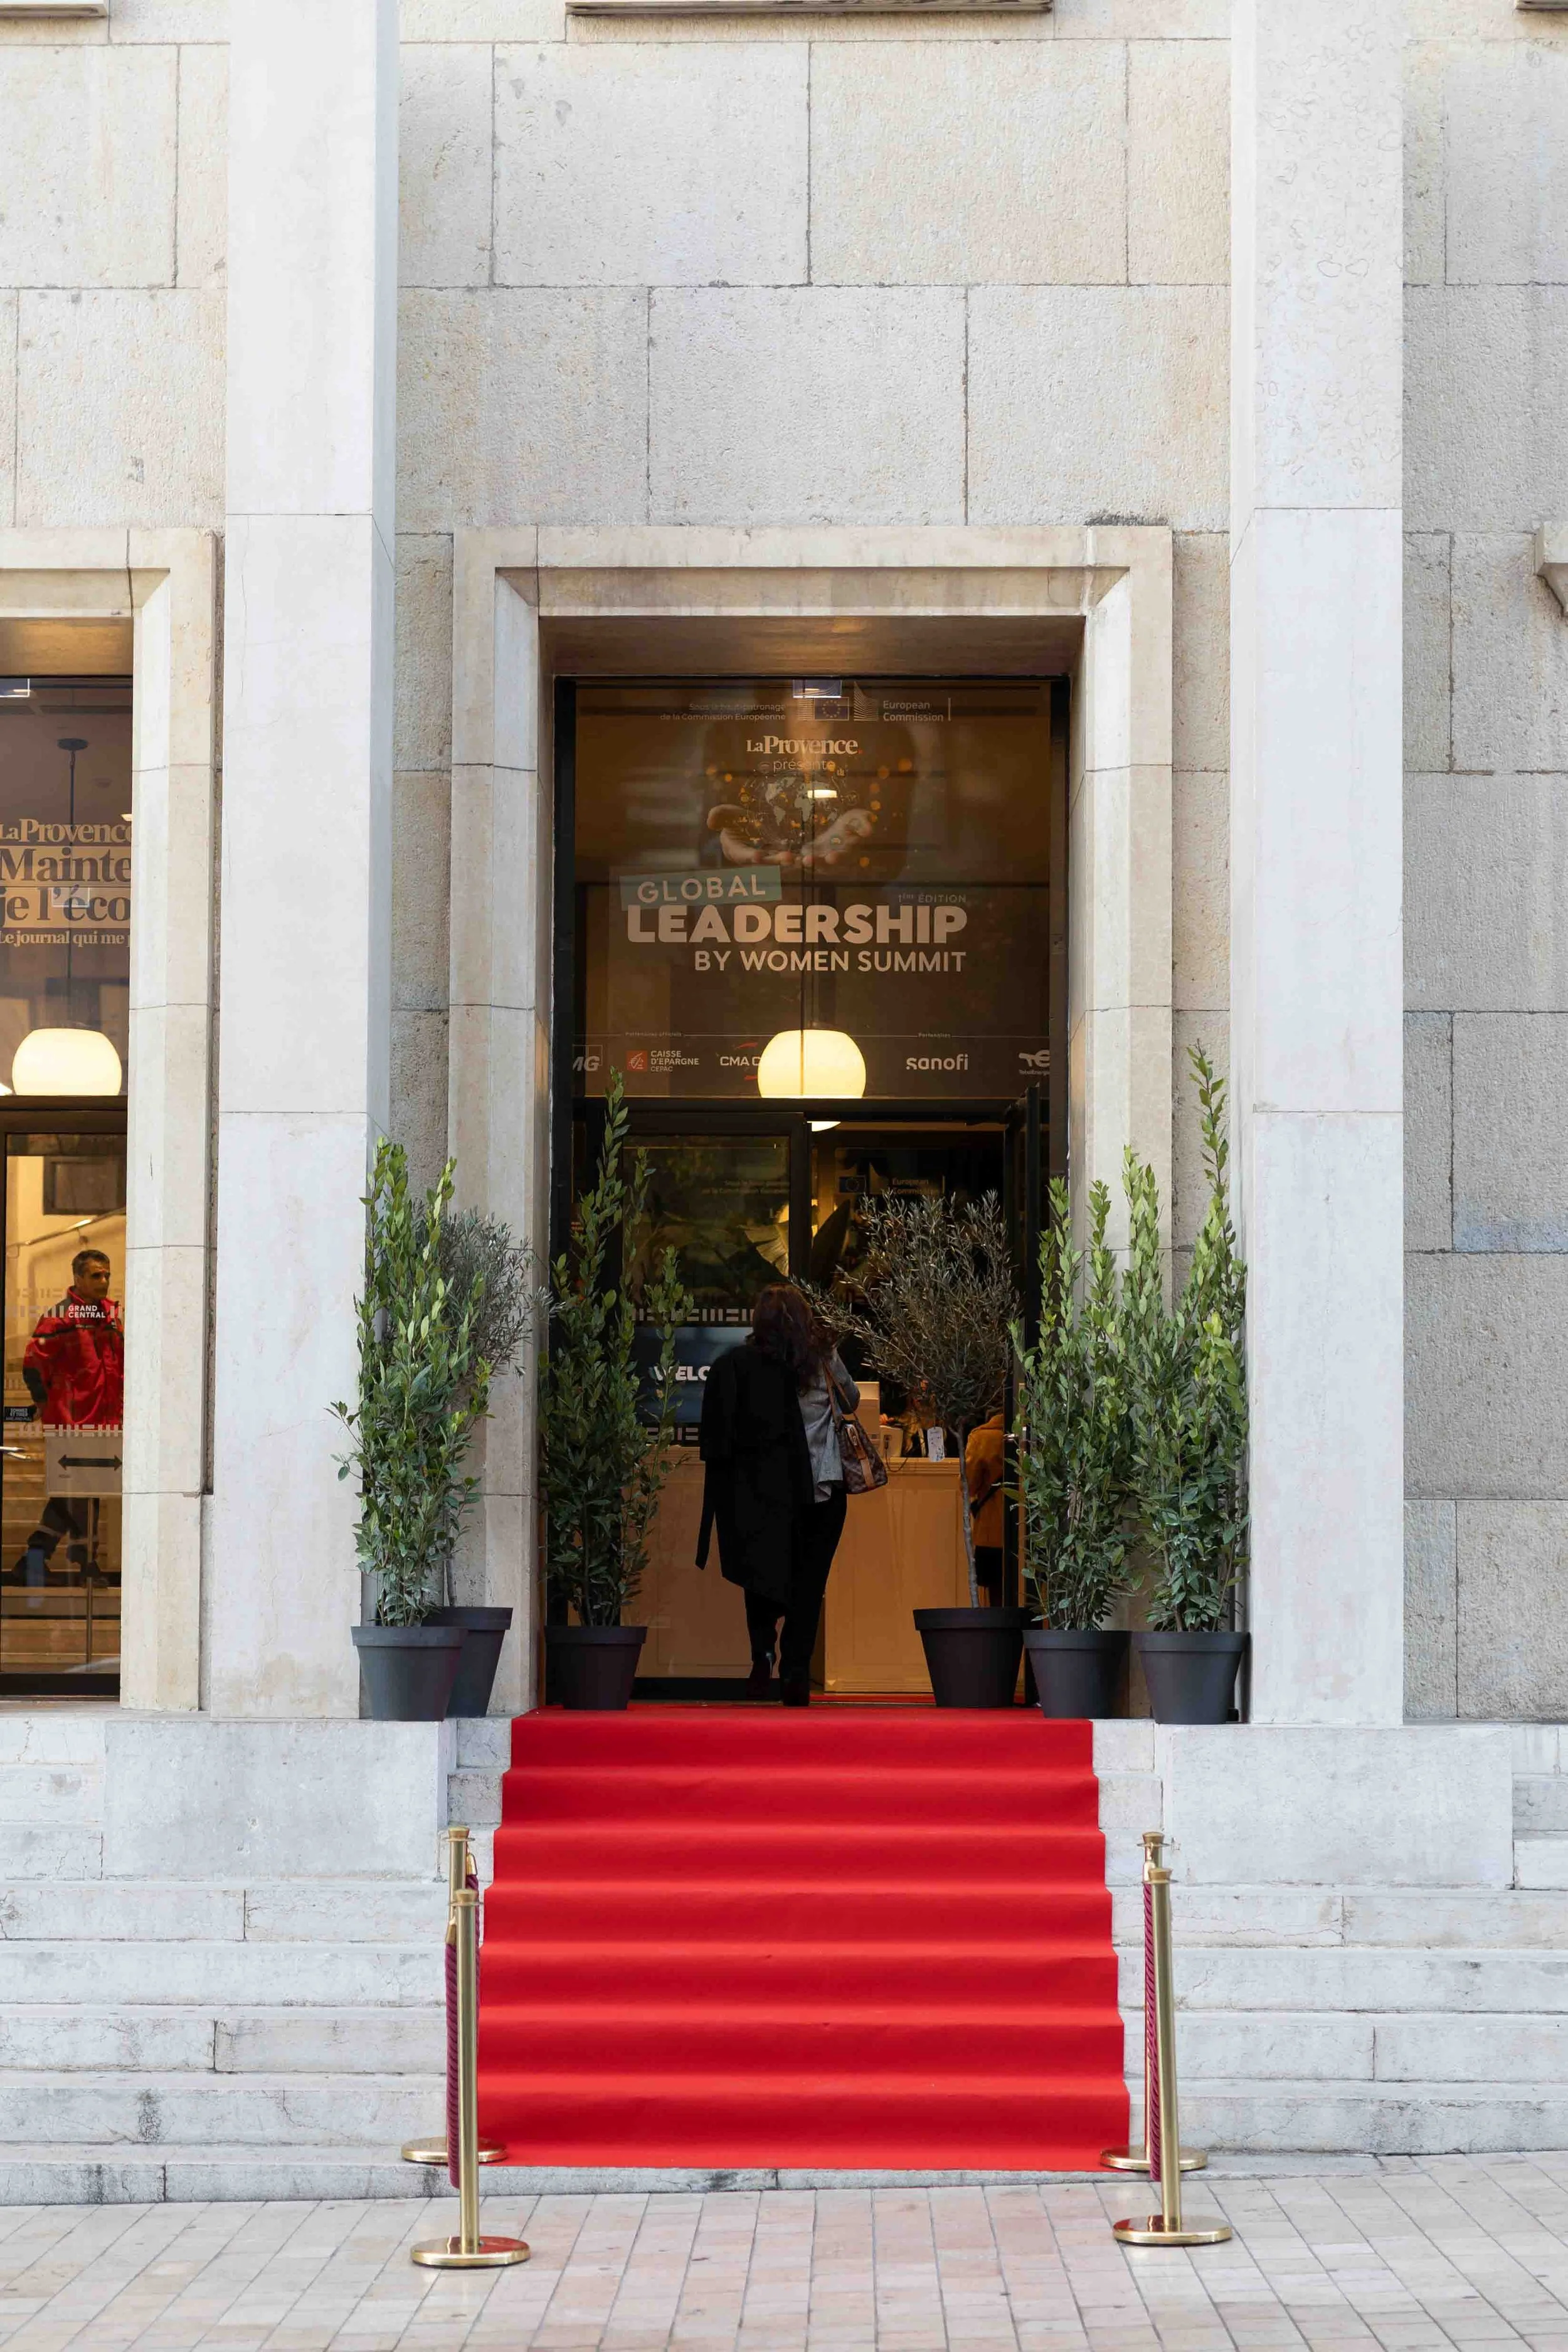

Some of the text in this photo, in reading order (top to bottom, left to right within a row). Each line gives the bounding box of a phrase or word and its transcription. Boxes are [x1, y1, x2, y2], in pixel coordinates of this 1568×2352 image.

[882, 700, 930, 711] European
[882, 712, 944, 721] Commission
[637, 873, 766, 903] GLOBAL
[918, 891, 967, 903] ÉDITION
[627, 904, 968, 943] LEADERSHIP
[14, 930, 70, 948] journal
[73, 930, 97, 948] qui
[100, 933, 125, 944] me
[696, 950, 967, 972] BY WOMEN SUMMIT
[720, 1056, 750, 1066] CMA
[906, 1053, 969, 1070] sanofi
